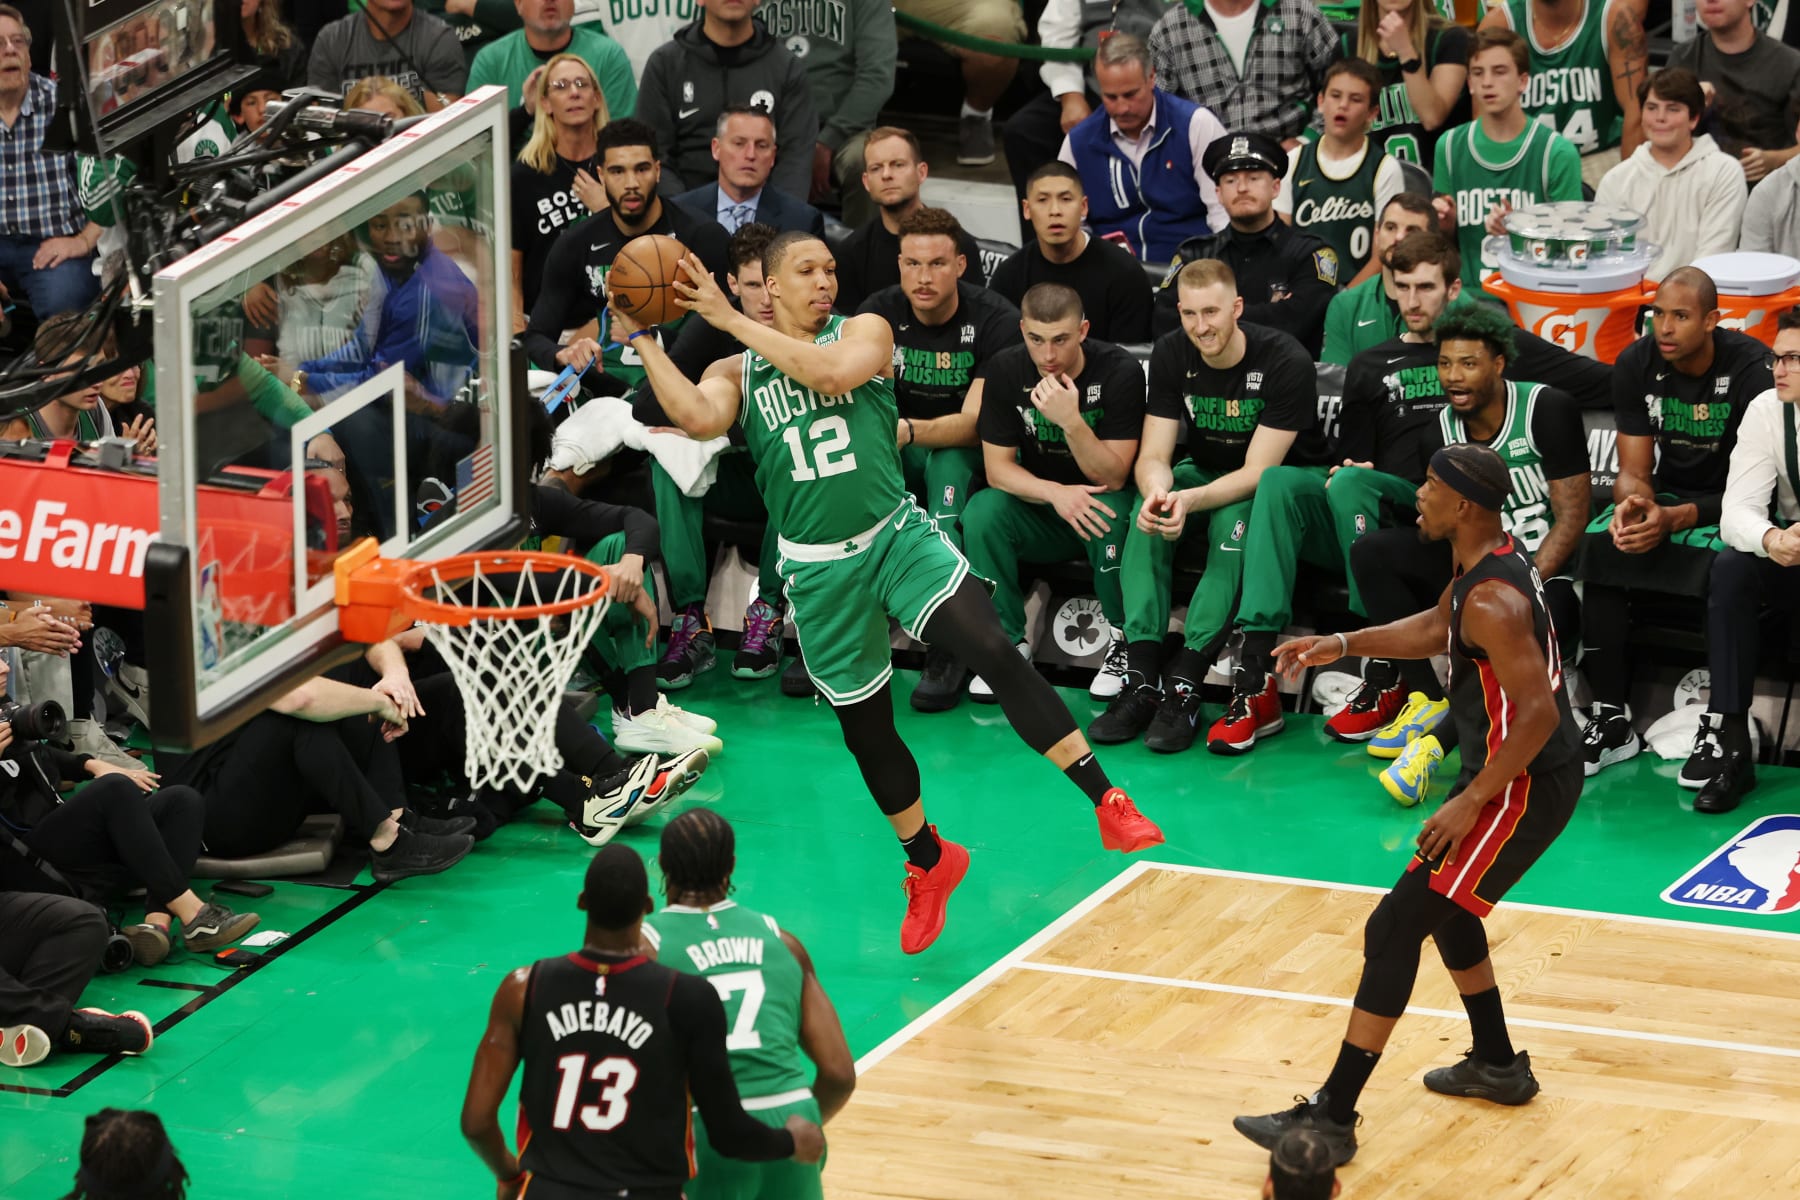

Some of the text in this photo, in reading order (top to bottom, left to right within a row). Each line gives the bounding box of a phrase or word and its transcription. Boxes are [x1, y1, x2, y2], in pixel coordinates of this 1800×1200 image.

[1296, 196, 1374, 227] Celtics
[1350, 226, 1370, 259] 0
[782, 414, 858, 482] 12
[1507, 437, 1528, 450] VISTA
[1510, 446, 1529, 458] PRINT
[23, 499, 161, 578] Farm
[1060, 598, 1106, 624] CELTICS
[1682, 883, 1757, 905] NBA
[685, 936, 764, 972] BROWN
[545, 1000, 654, 1050] ADEBAYO
[707, 969, 766, 1051] 7
[551, 1052, 639, 1132] 13
